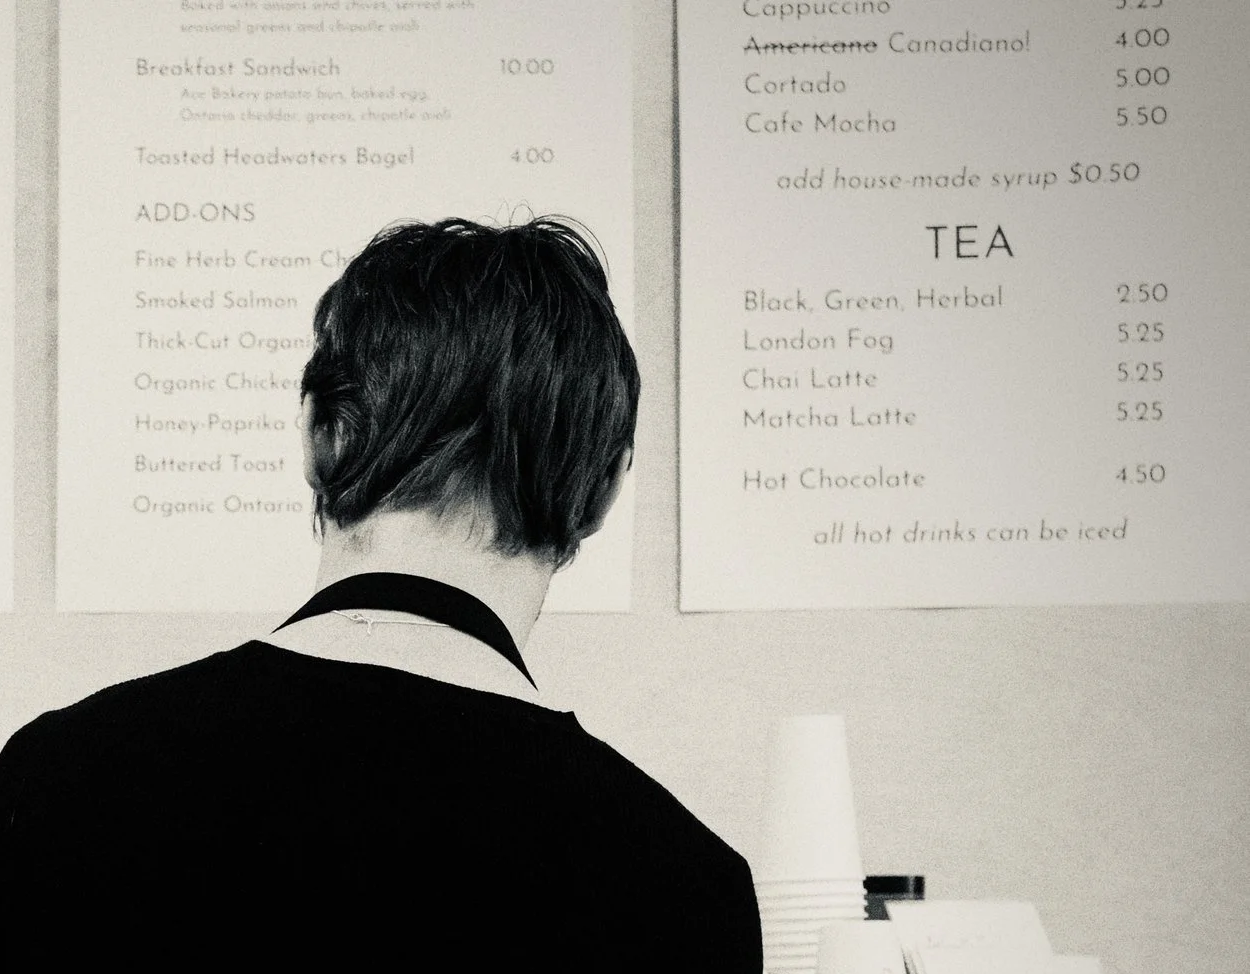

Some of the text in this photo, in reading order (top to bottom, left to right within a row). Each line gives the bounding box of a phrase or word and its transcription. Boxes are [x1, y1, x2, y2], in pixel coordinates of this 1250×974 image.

[742, 0, 891, 20] Cappuccino
[744, 31, 1029, 54] Americano Canadiano!
[1116, 28, 1170, 47] 4.00
[136, 57, 340, 76] Breakfast Sandwich
[501, 58, 554, 75] 10.00
[1117, 66, 1170, 87] 5.00
[744, 71, 846, 94] Cortado
[745, 111, 896, 133] Cafe Mocha
[1117, 106, 1167, 126] 5.50
[136, 146, 414, 169] Toasted Headwaters Bagel
[511, 147, 554, 164] 4.00
[777, 162, 1140, 190] add house-made syrup $0.50
[136, 202, 255, 222] ADD-ONS
[926, 225, 1013, 259] TEA
[135, 250, 176, 268] Fine
[186, 250, 236, 267] Herb
[244, 250, 311, 268] Cream
[135, 290, 298, 309] Smoked Salmon
[745, 285, 1002, 311] Black, Green, Herbal
[1117, 283, 1168, 303] 2.50
[136, 331, 311, 352] Thick-Cut Organi
[744, 328, 893, 354] London Fog
[1118, 322, 1164, 343] 5.25
[742, 368, 877, 390] Chai Latte
[1118, 362, 1163, 382] 5.25
[134, 372, 215, 395] Organic
[744, 406, 916, 428] Matcha Latte
[1118, 401, 1163, 421] 5.25
[135, 413, 285, 434] Honey-Paprika
[135, 454, 284, 472] Buttered Toast
[1116, 464, 1166, 483] 4.50
[743, 466, 925, 490] Hot Chocolate
[132, 495, 302, 517] Organic Ontario
[814, 518, 1128, 544] all hot drinks can be iced
